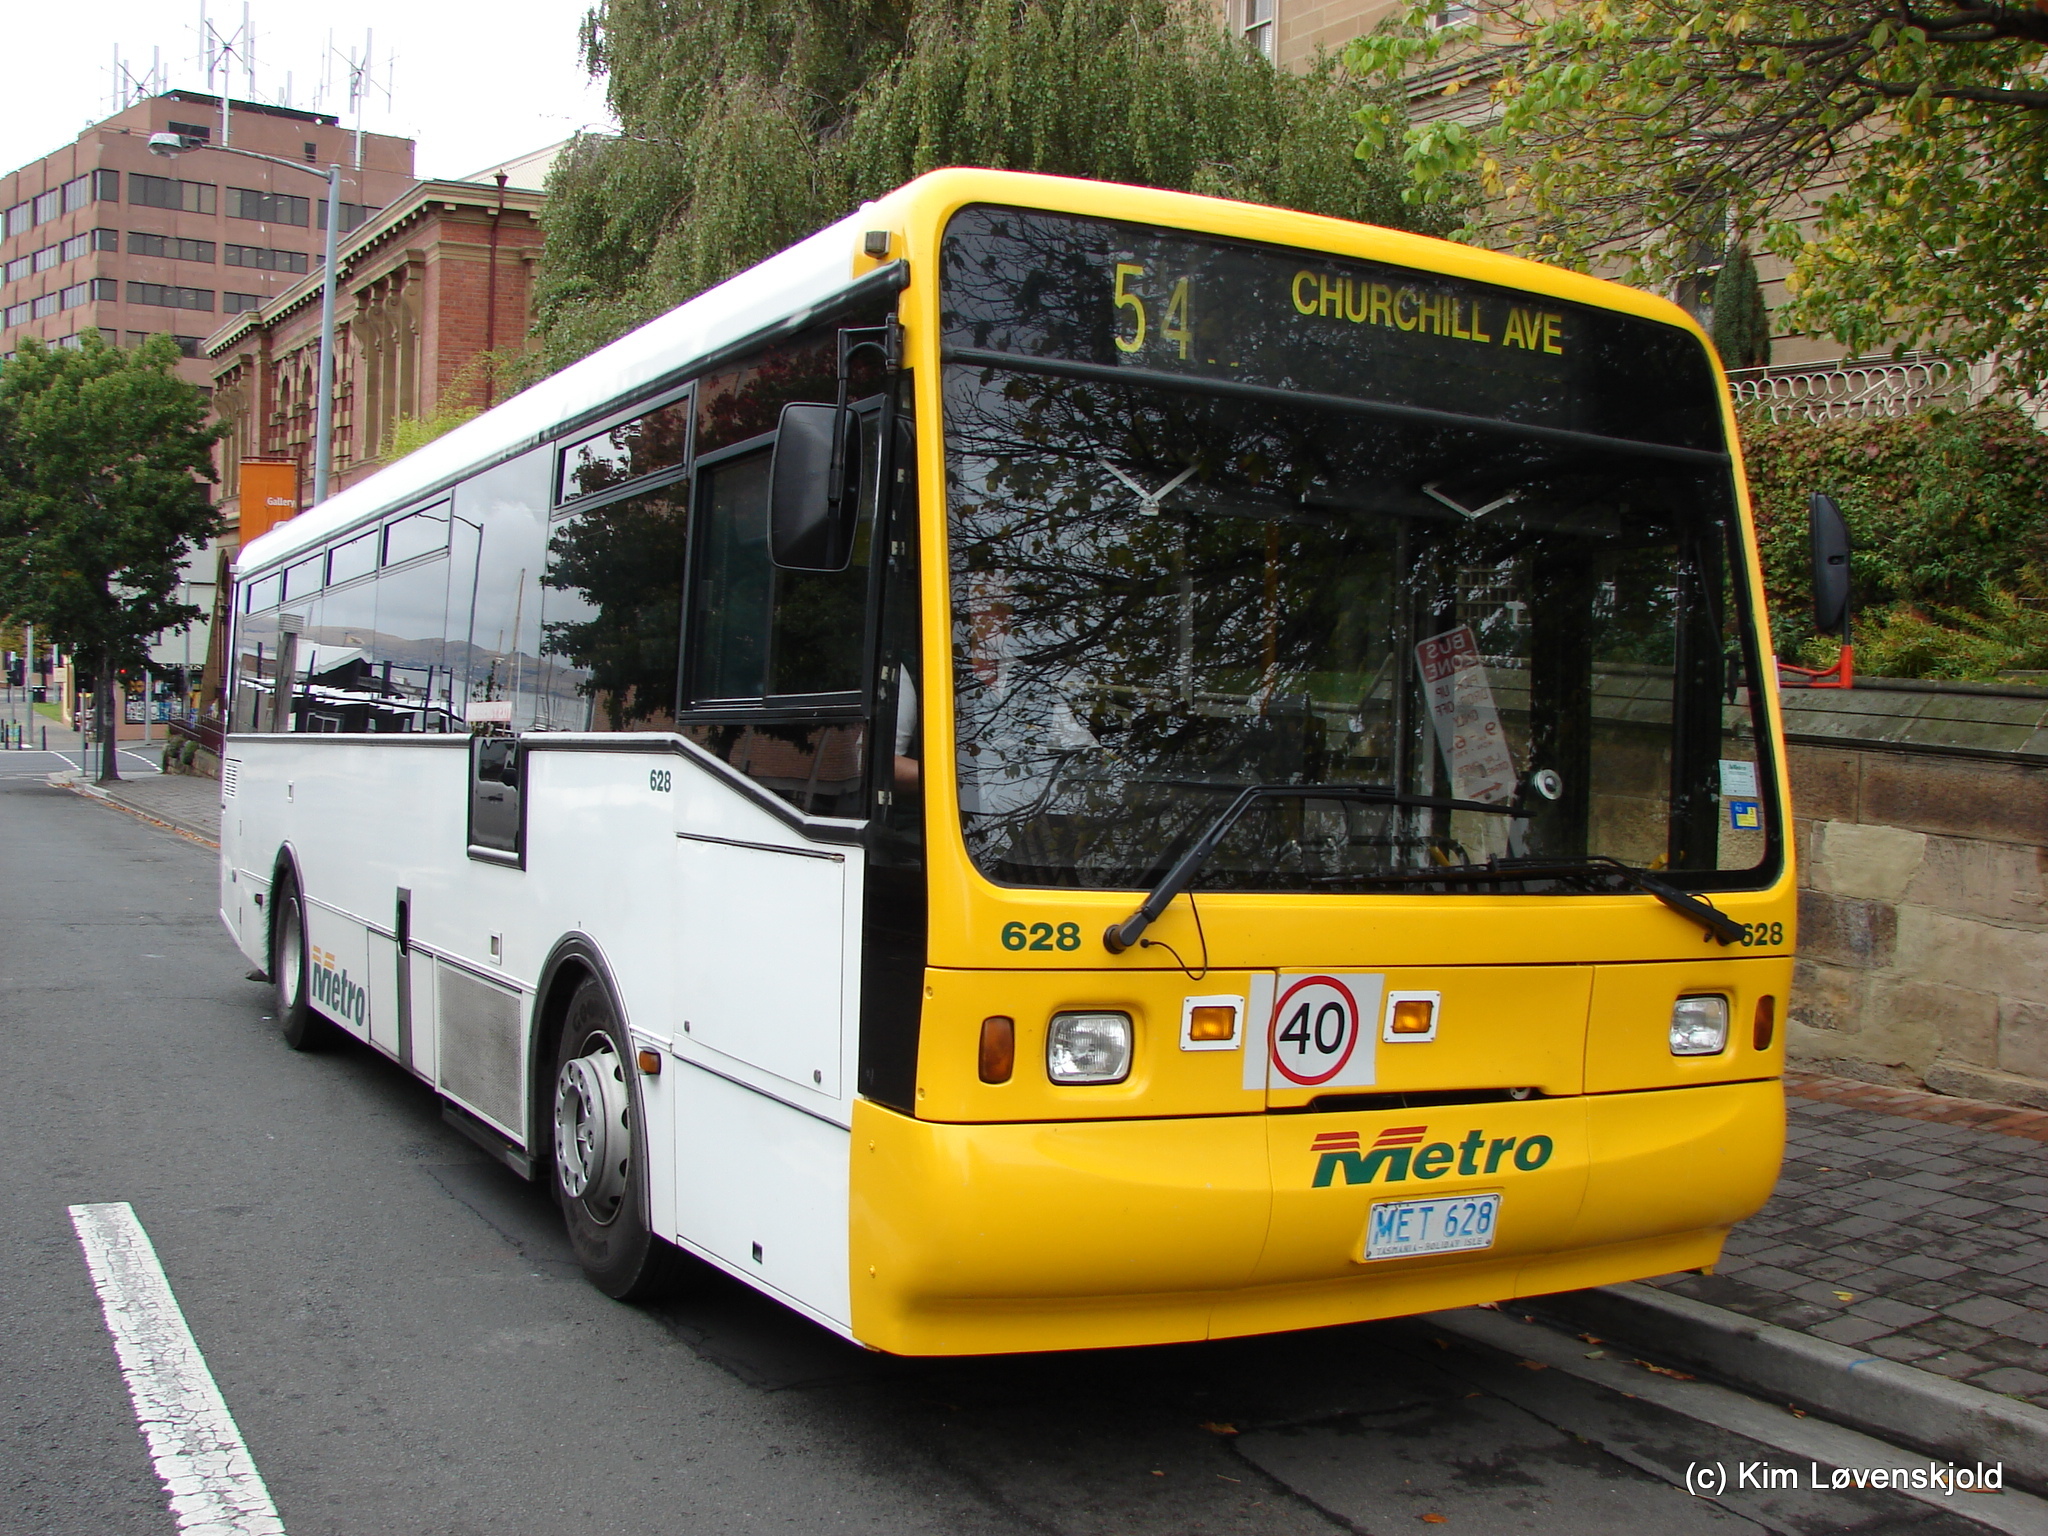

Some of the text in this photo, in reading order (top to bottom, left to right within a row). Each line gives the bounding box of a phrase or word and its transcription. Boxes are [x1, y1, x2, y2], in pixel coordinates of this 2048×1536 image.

[1113, 262, 1193, 361] 54
[1290, 269, 1563, 355] CHURCHILL AVE
[266, 496, 297, 509] Gallery
[650, 768, 671, 793] 628
[1001, 921, 1081, 951] 628
[1740, 921, 1783, 947] 628
[312, 945, 365, 1027] Metro
[1279, 1001, 1345, 1055] 40
[1310, 1125, 1553, 1188] Metro
[1373, 1201, 1493, 1245] MET 628
